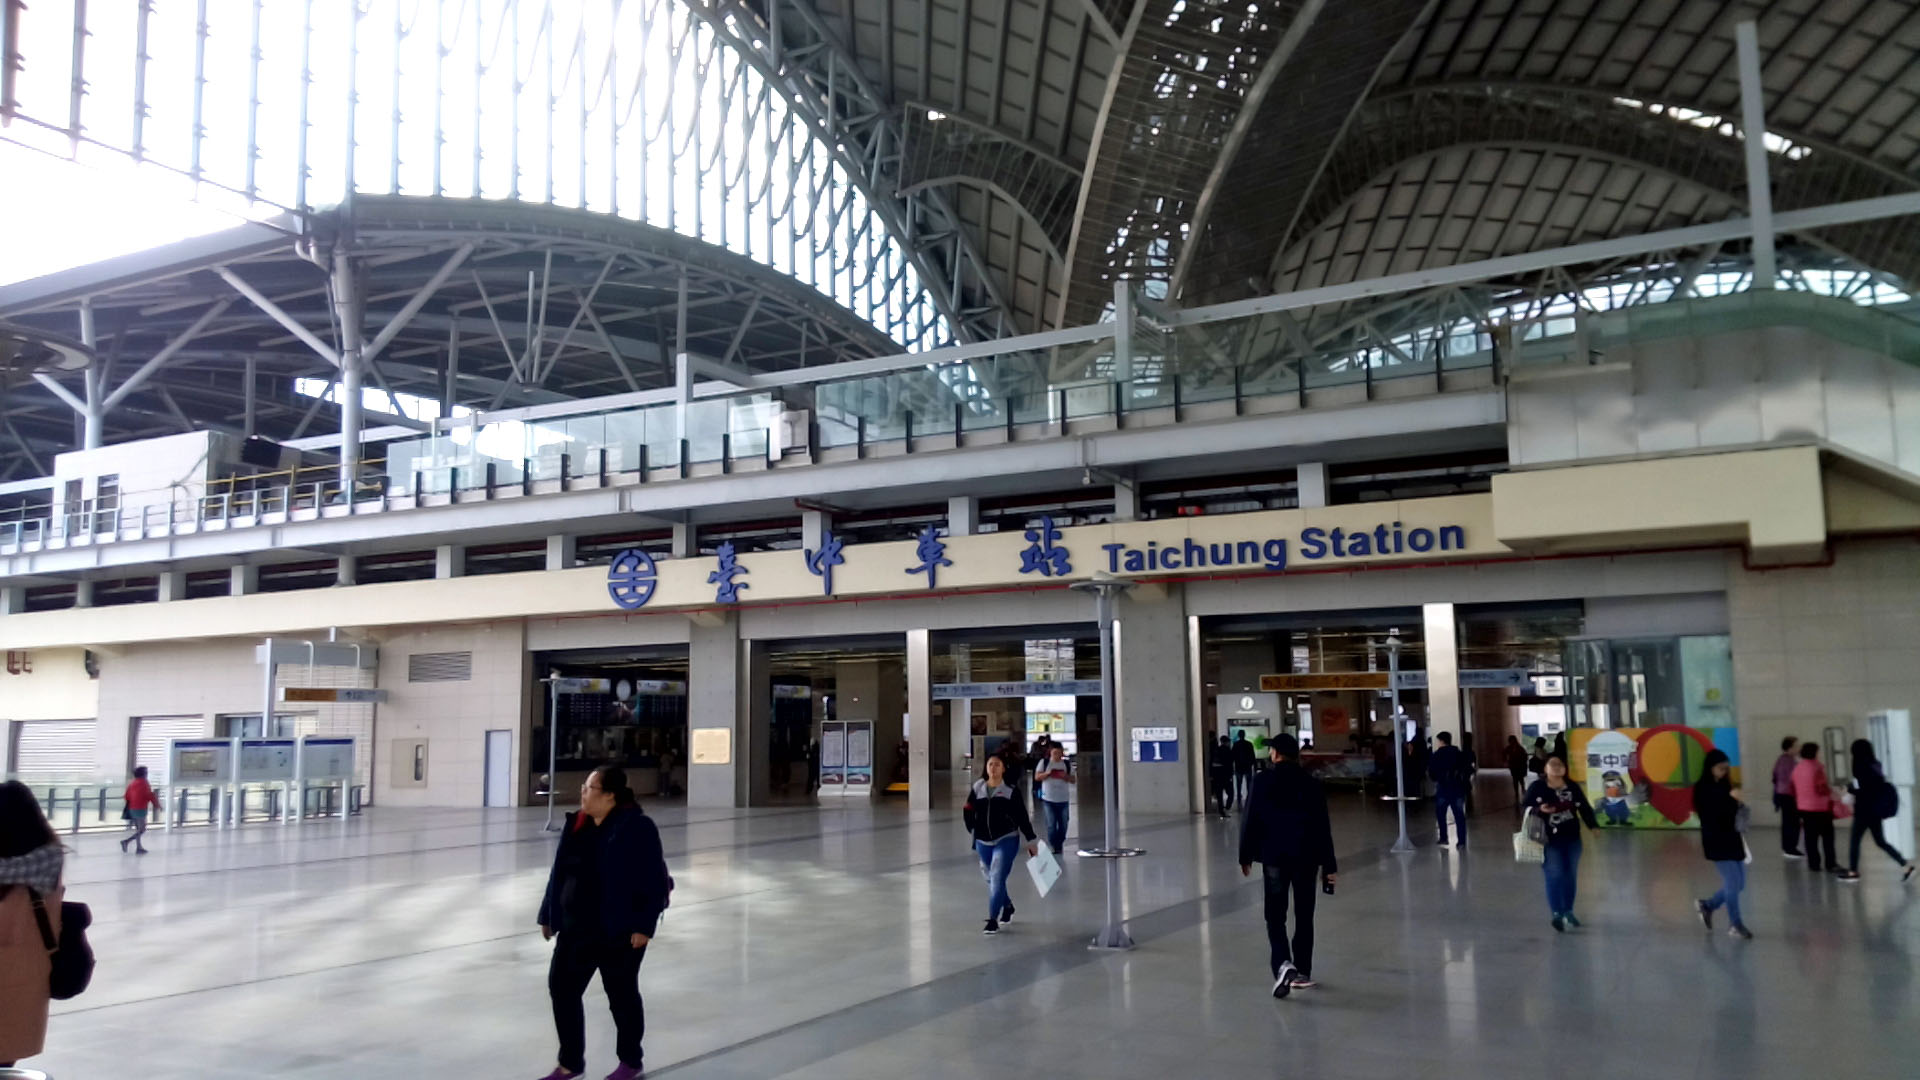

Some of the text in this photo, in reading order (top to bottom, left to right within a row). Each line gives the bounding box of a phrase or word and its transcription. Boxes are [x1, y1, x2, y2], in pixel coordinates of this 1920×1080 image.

[706, 515, 1073, 603] 臺中車站
[1101, 521, 1466, 573] Taichung Station
[1152, 741, 1163, 760] 1
